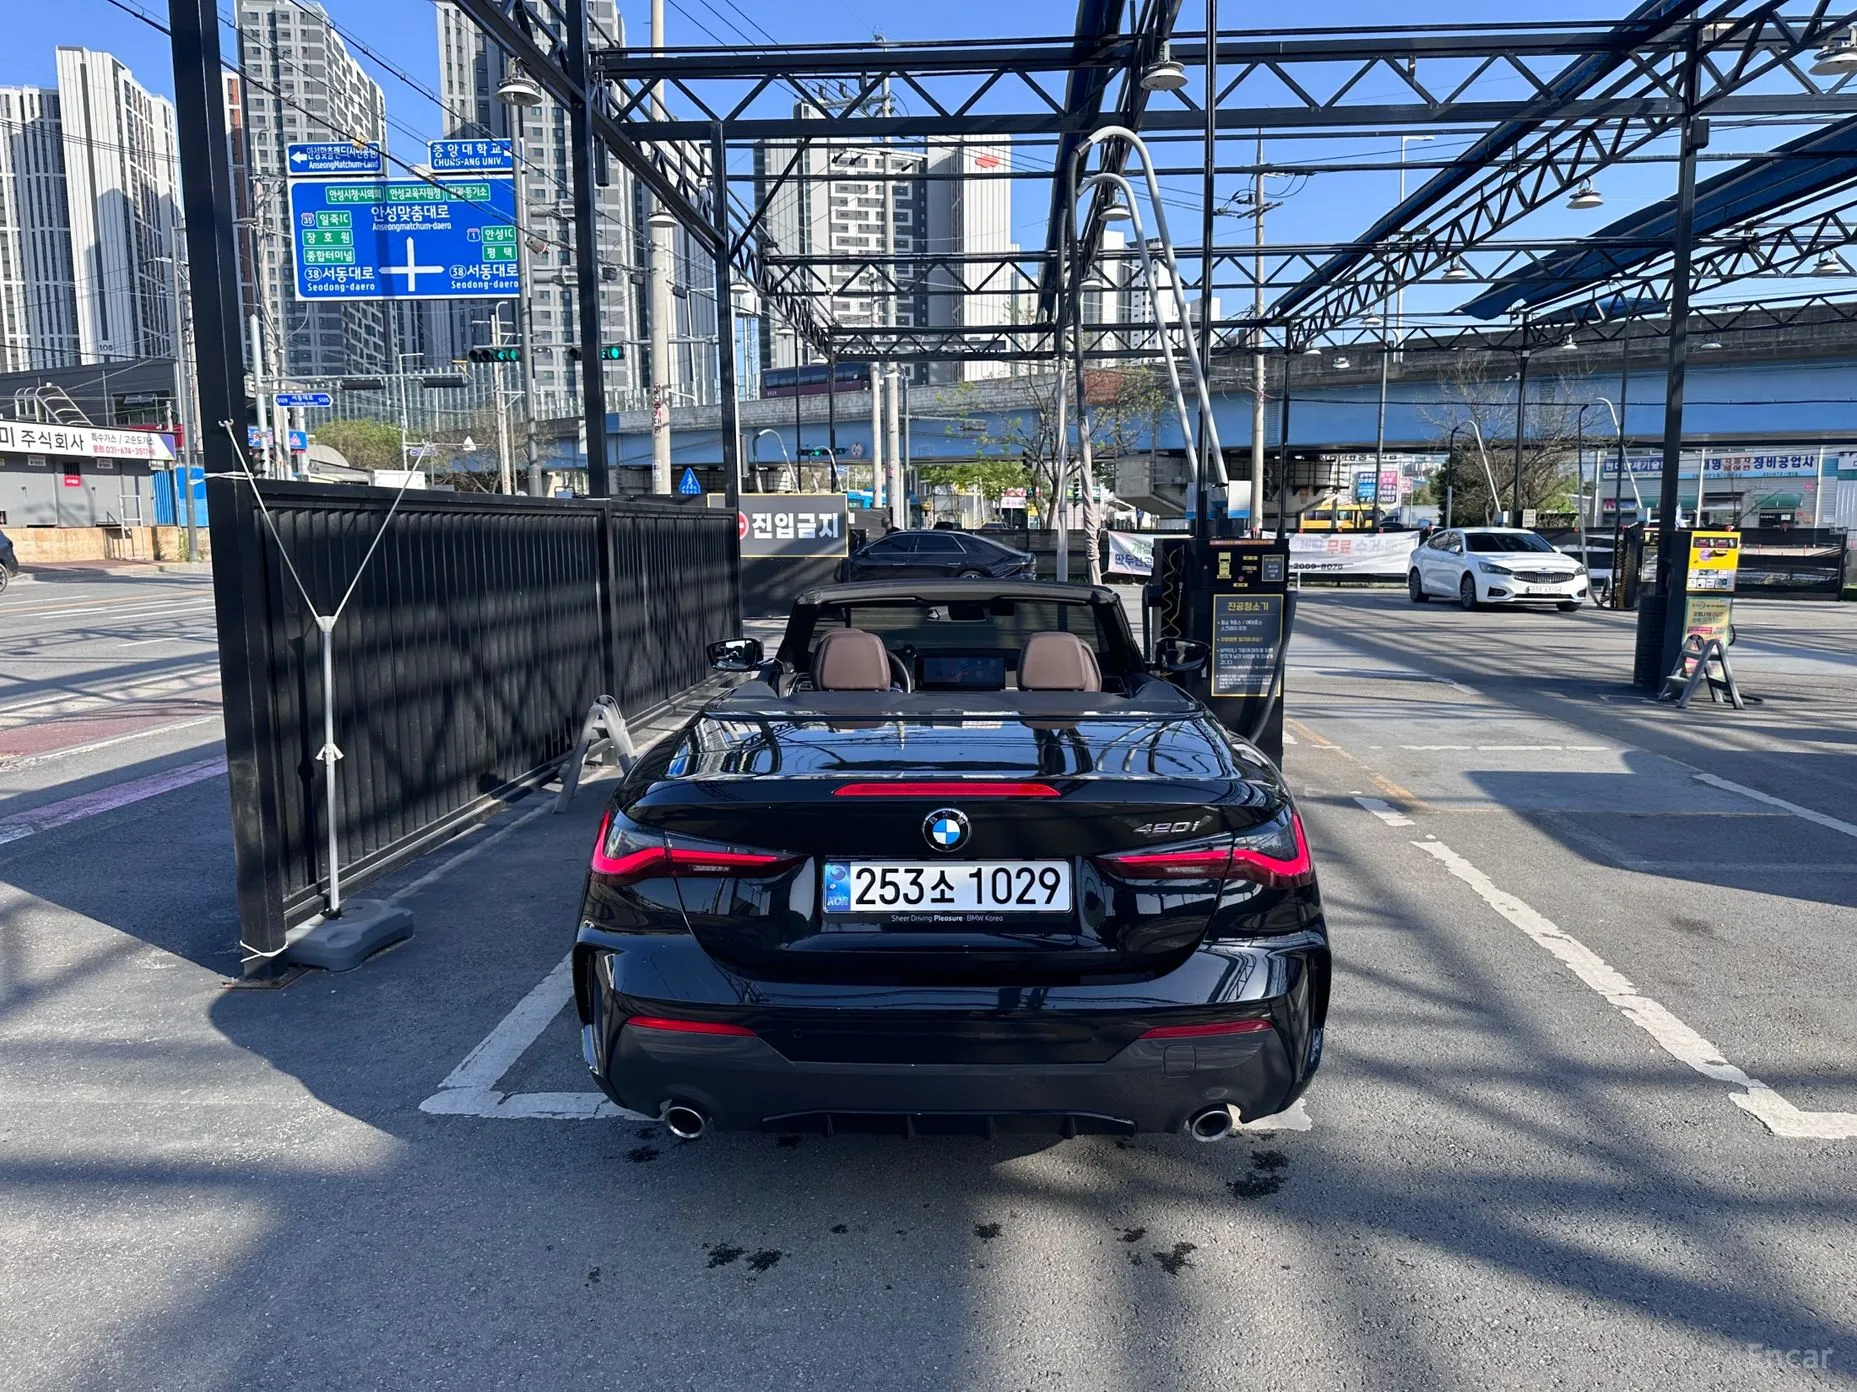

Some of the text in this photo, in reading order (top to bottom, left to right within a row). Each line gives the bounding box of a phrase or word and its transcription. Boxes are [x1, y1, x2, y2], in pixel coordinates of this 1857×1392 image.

[433, 157, 504, 167] CHUNG-ANG UNIV.
[388, 187, 441, 200] 안성교육지원청
[319, 213, 348, 226] 일죽IC
[371, 204, 450, 222] 안성맞춤대로
[372, 222, 452, 232] Anseongmatchum-daero
[484, 228, 513, 240] 안성IC
[306, 250, 353, 263] 종합터미널
[322, 266, 375, 283] 서동대로
[467, 263, 519, 281] 서동대로
[307, 283, 375, 292] Seodong-daero
[451, 280, 519, 290] Seodong-daero
[21, 430, 84, 451] 주식회사
[1753, 456, 1815, 470] 정비공업사
[752, 512, 839, 539] 진입금지
[1327, 539, 1352, 556] 무료
[1227, 601, 1269, 611] 진공청소기
[1133, 820, 1201, 834] 420i
[855, 866, 1061, 905] 253소 1029
[911, 914, 933, 923] Driving
